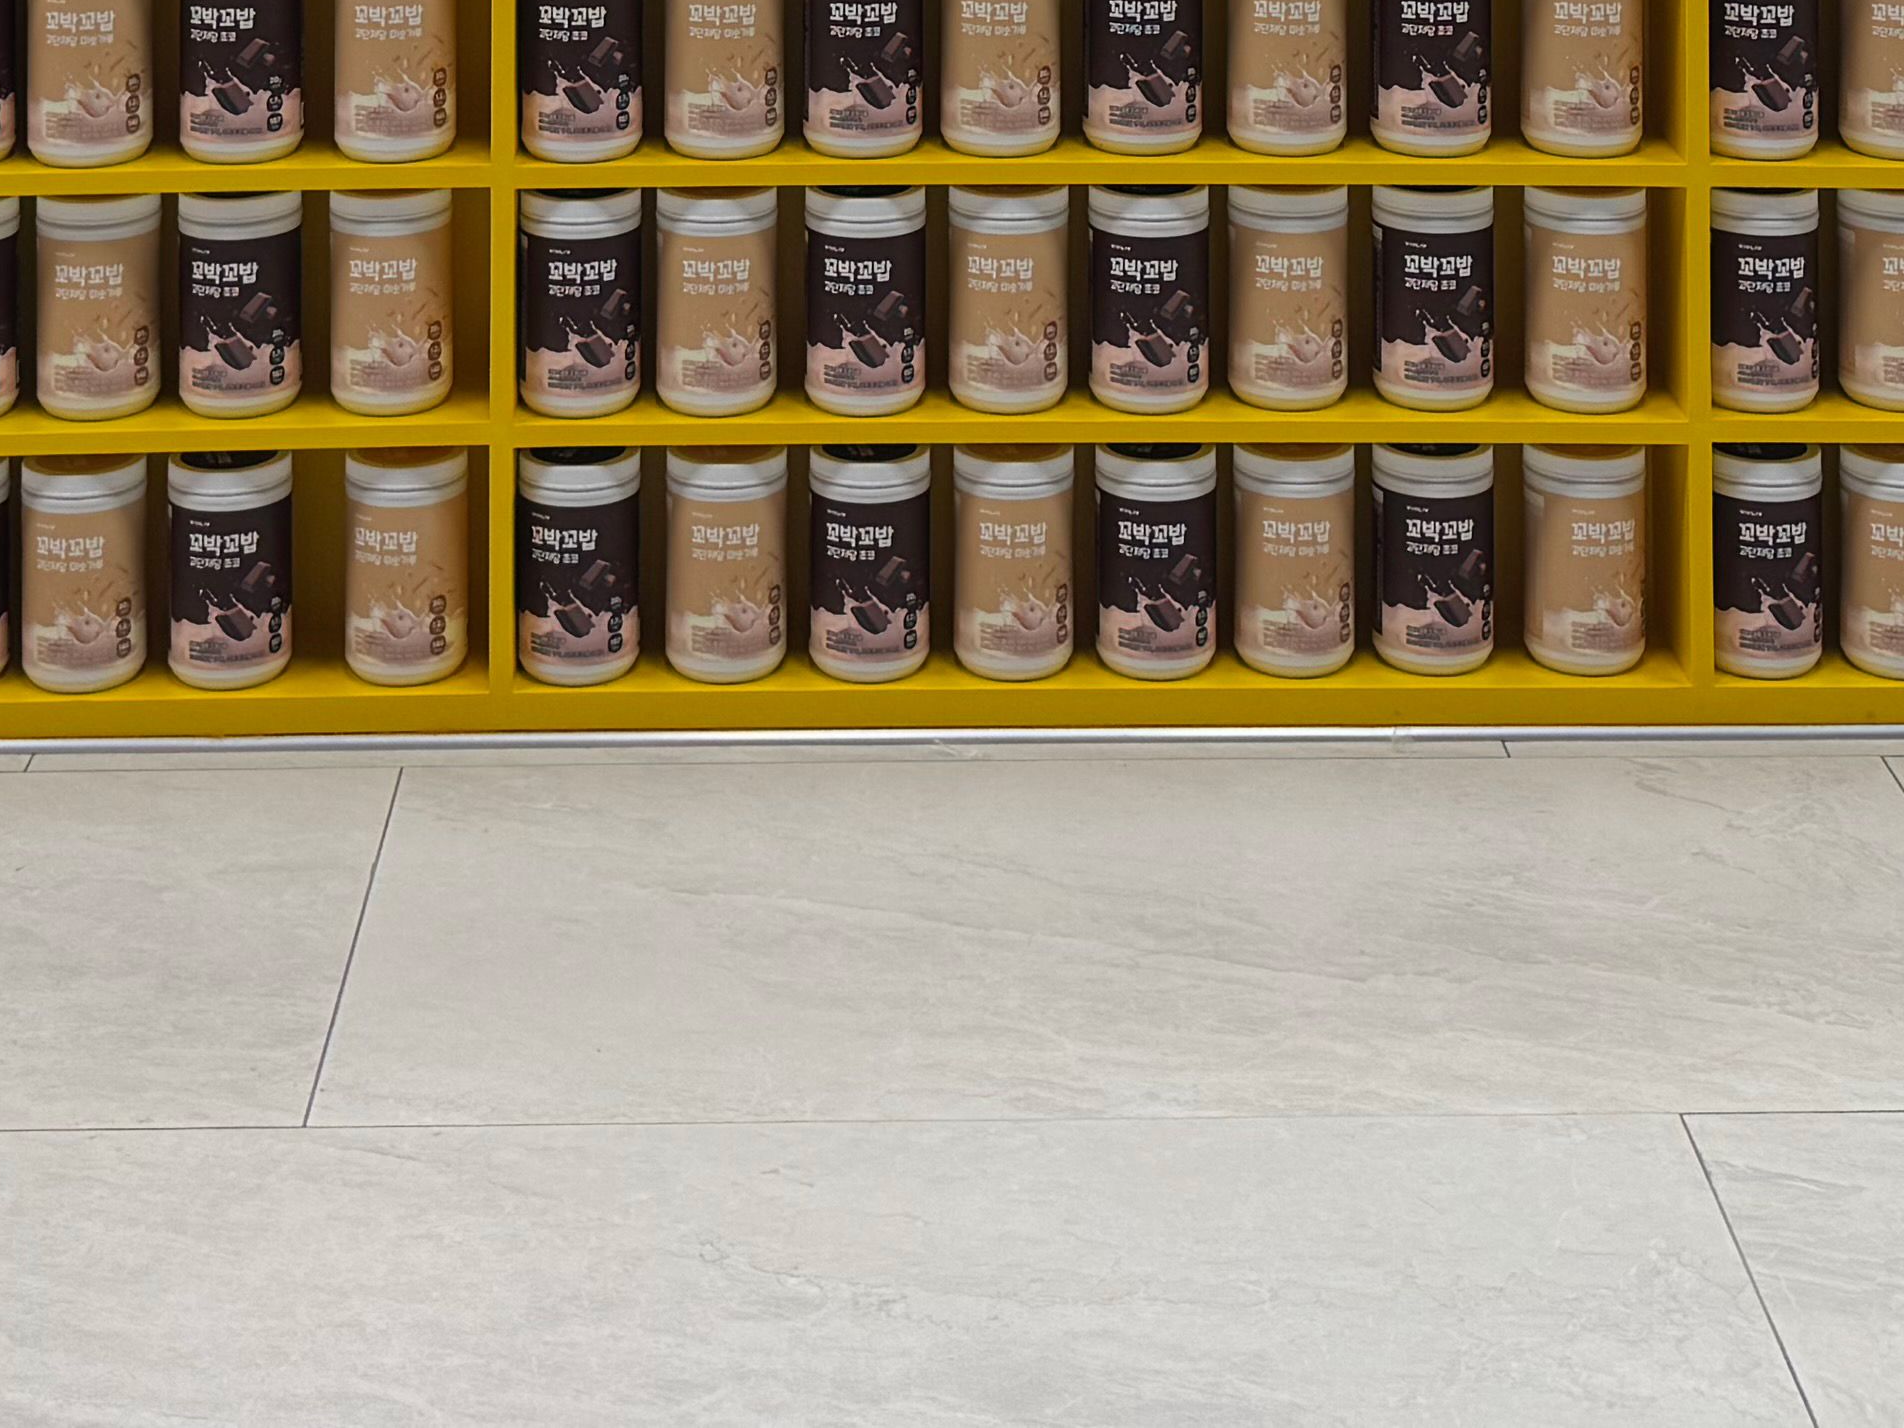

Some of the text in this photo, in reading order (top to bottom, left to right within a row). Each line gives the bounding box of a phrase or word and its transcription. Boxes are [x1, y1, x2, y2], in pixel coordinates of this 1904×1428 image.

[355, 4, 423, 27] 꼬박꼬밥
[1109, 0, 1177, 22] 꼬박꼬밥
[1725, 3, 1794, 26] 꼬박꼬밥
[350, 258, 417, 282] 꼬박꼬밥
[968, 256, 1033, 279] 꼬박꼬밥
[1738, 257, 1804, 280] 꼬박꼬밥
[692, 524, 760, 548] 꼬박꼬밥
[1263, 521, 1330, 543] 꼬박꼬밥
